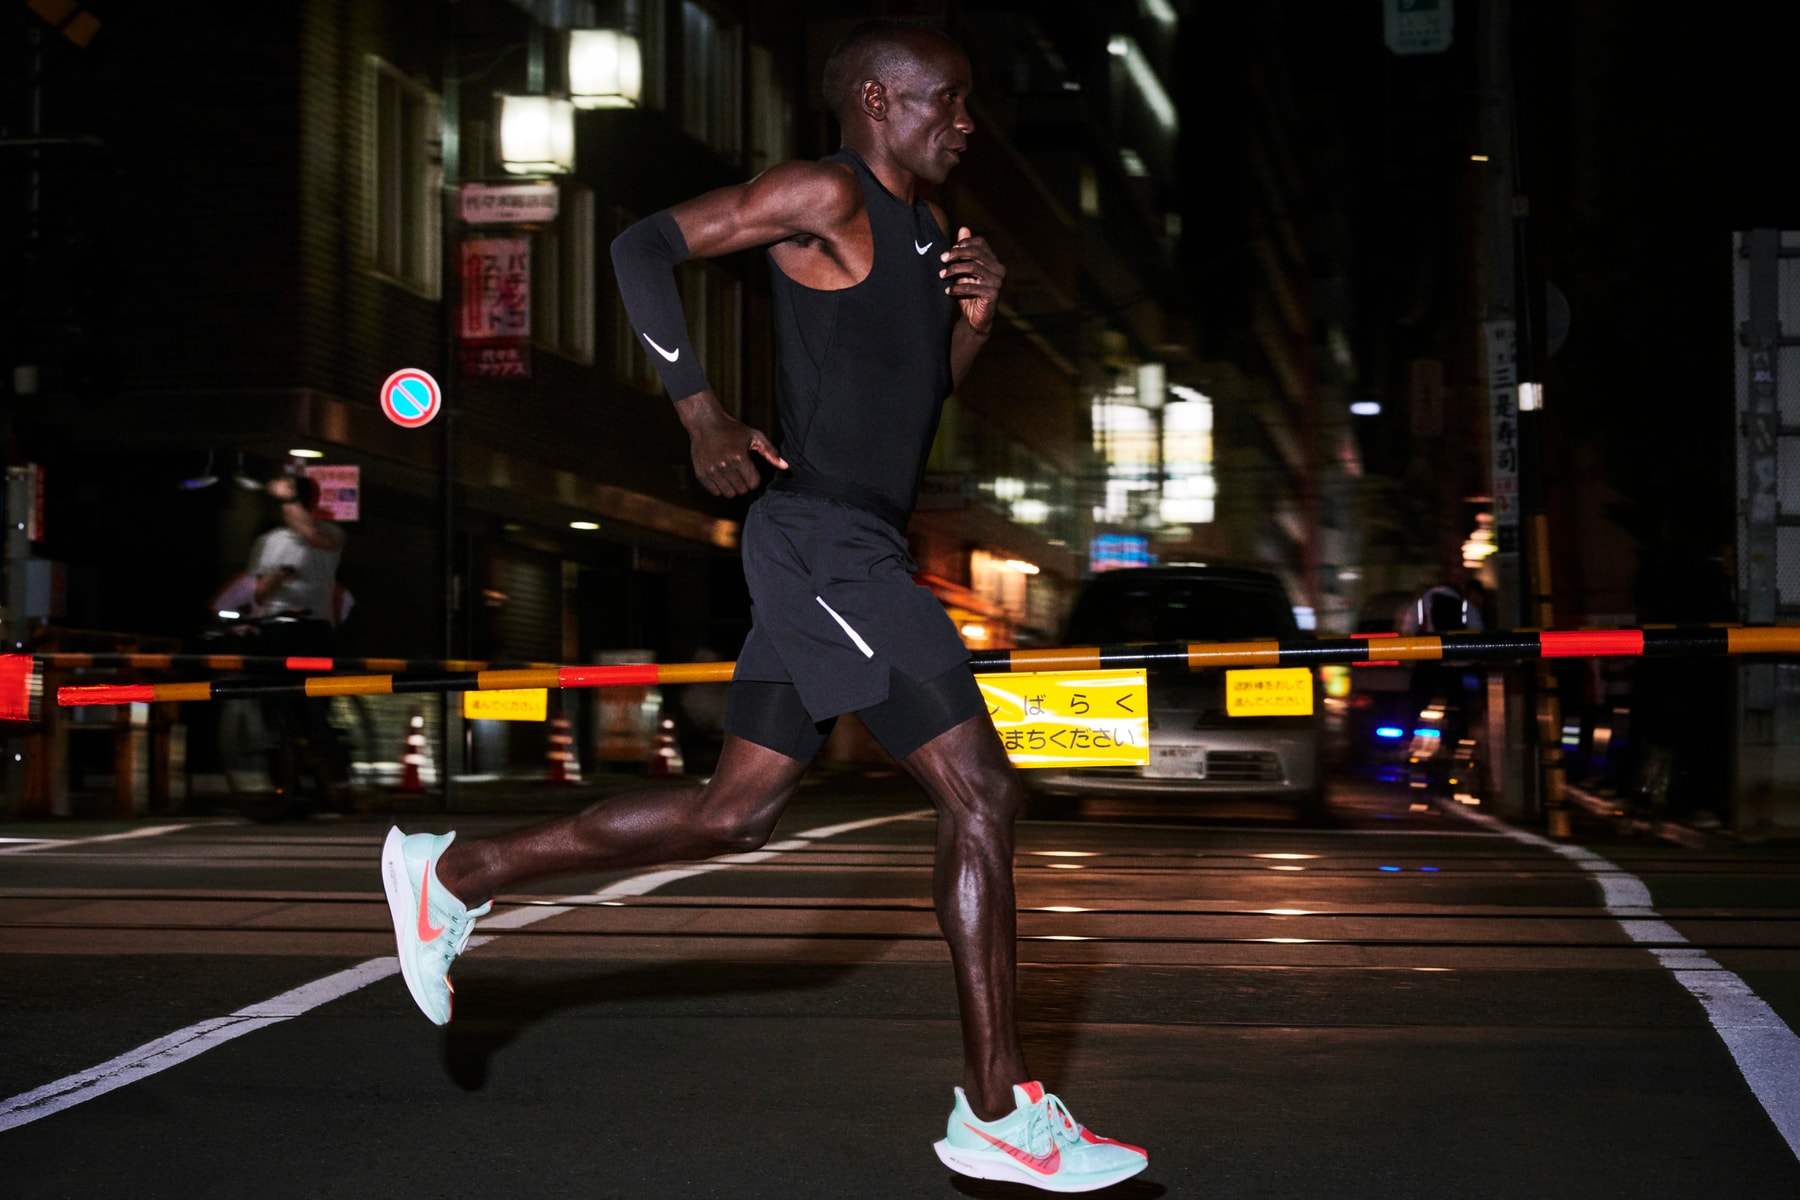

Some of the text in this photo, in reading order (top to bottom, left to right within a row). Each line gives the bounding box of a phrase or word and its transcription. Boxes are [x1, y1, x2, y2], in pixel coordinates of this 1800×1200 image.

[997, 727, 1135, 750] まちください
